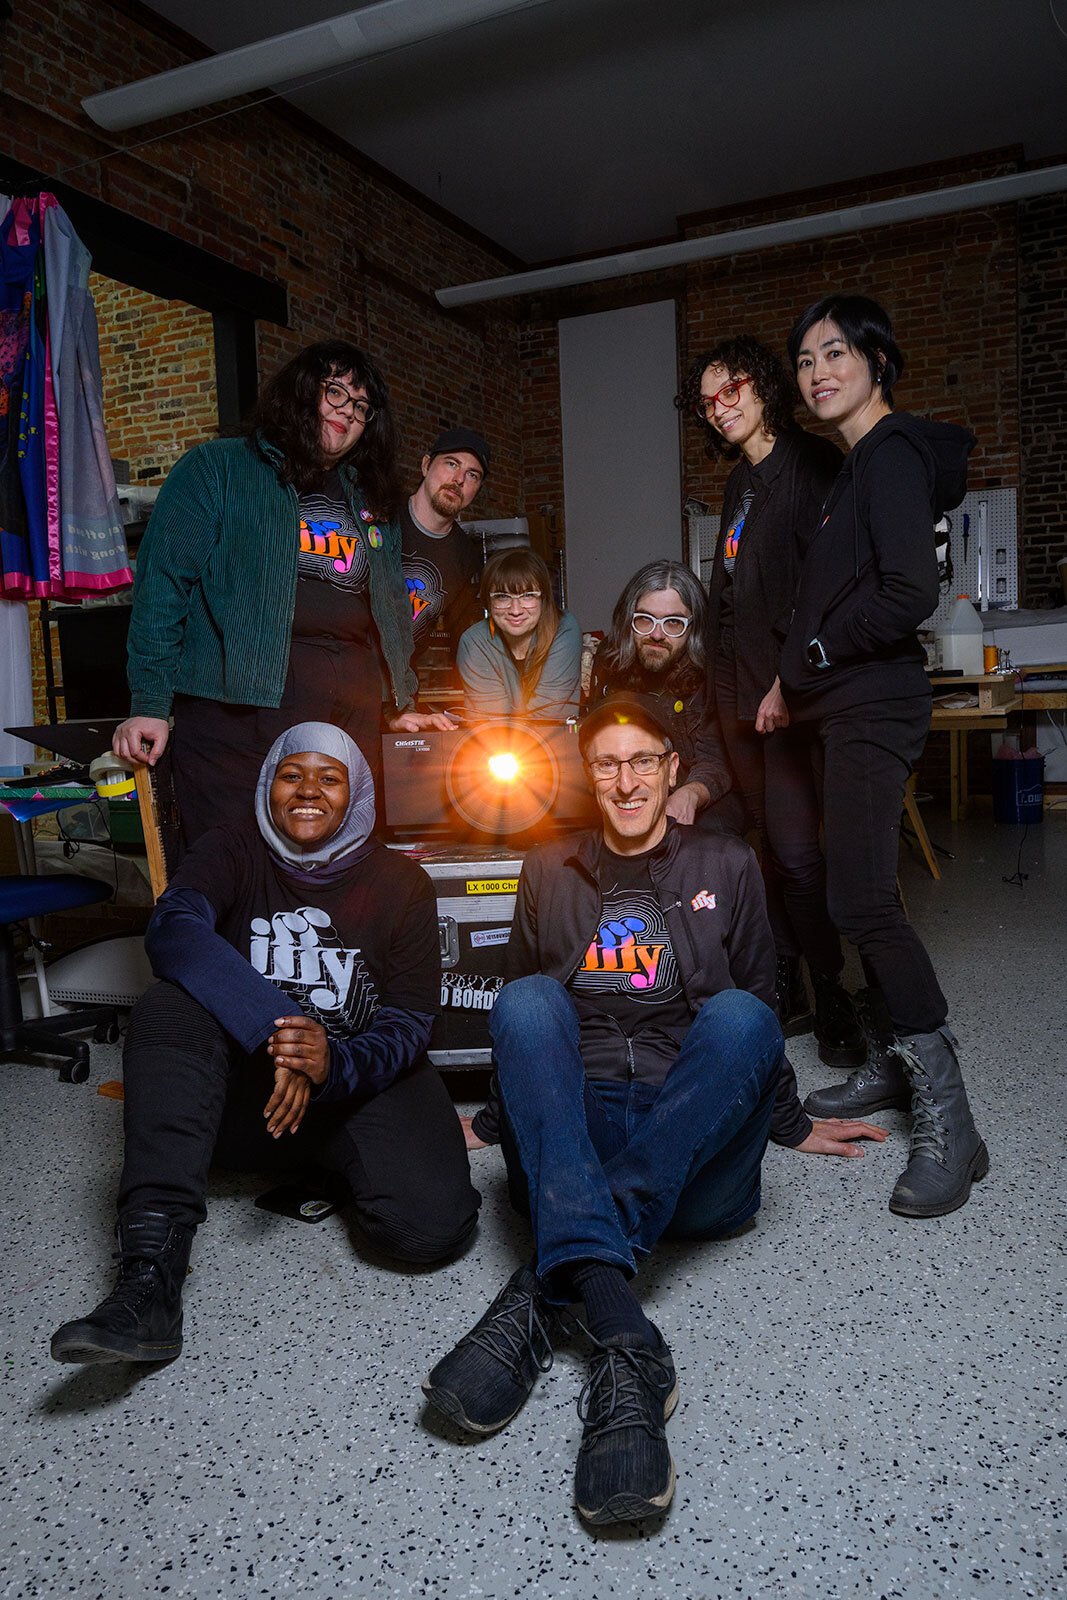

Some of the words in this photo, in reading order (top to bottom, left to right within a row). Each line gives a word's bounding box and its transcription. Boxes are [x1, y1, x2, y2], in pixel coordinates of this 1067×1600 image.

[481, 883, 500, 891] 1000
[502, 882, 517, 890] Chr
[691, 890, 717, 912] iffy
[249, 906, 361, 1011] iffy
[579, 916, 667, 990] iffy
